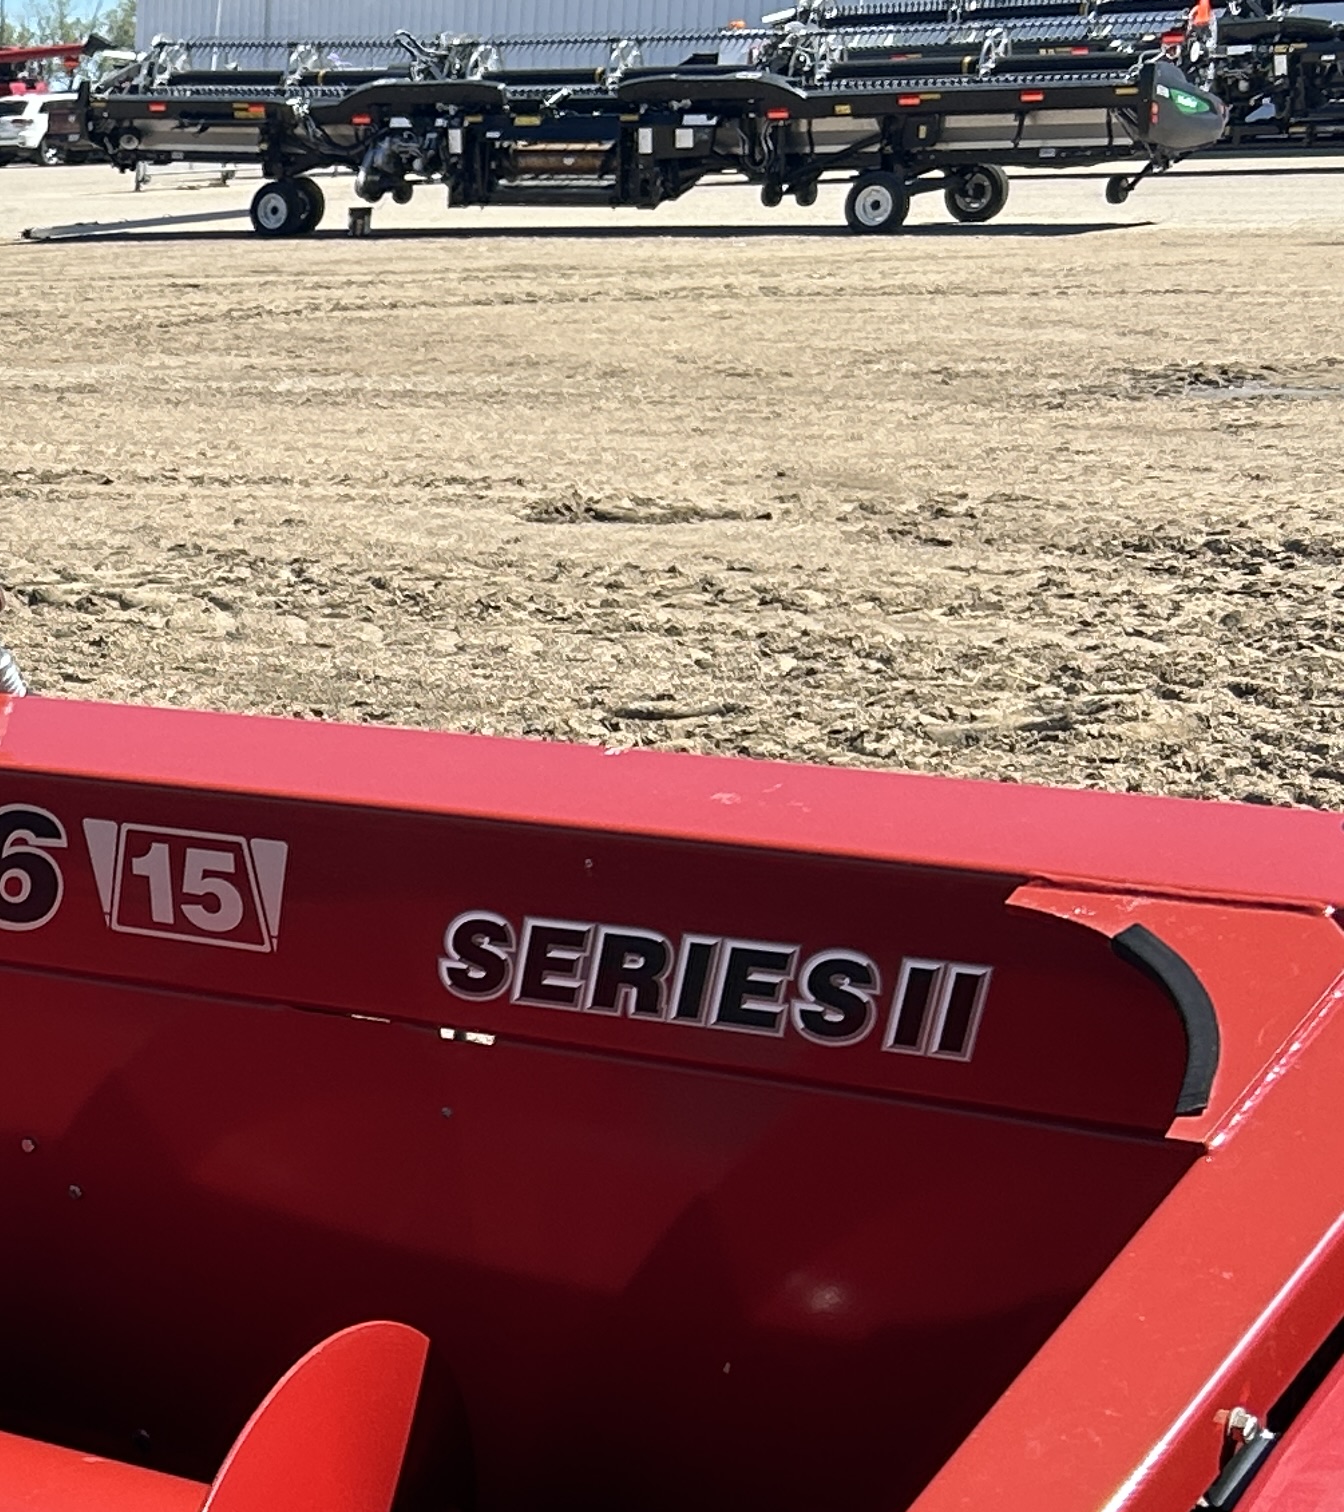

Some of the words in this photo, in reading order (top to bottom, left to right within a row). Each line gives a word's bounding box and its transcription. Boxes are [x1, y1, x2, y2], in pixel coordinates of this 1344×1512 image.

[131, 842, 244, 933] 15
[438, 910, 881, 1047] SERIES
[881, 956, 994, 1062] II
